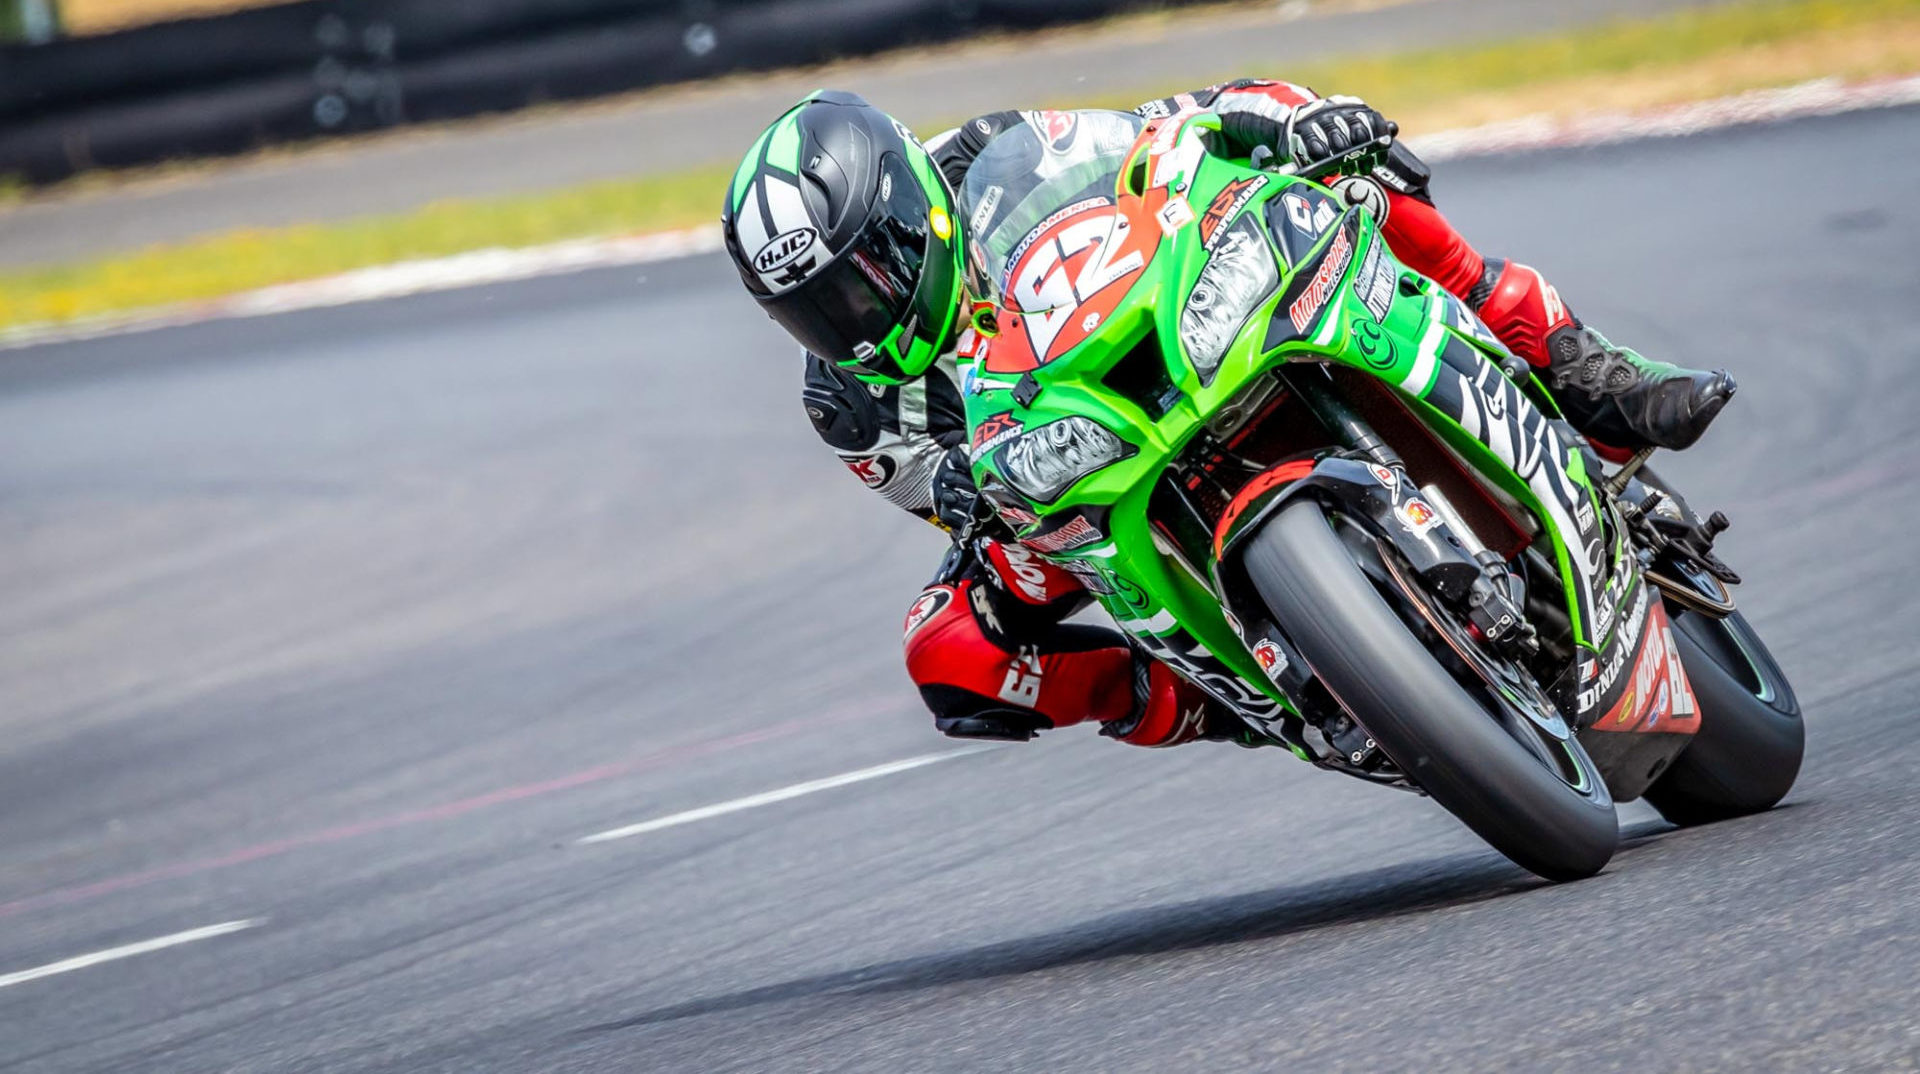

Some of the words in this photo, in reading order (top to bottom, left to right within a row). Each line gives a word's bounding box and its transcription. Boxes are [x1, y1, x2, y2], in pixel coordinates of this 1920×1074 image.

[974, 187, 996, 232] UNLOP
[1204, 174, 1269, 252] PERFORMANCE
[758, 230, 807, 270] HJC
[1012, 213, 1146, 366] 62
